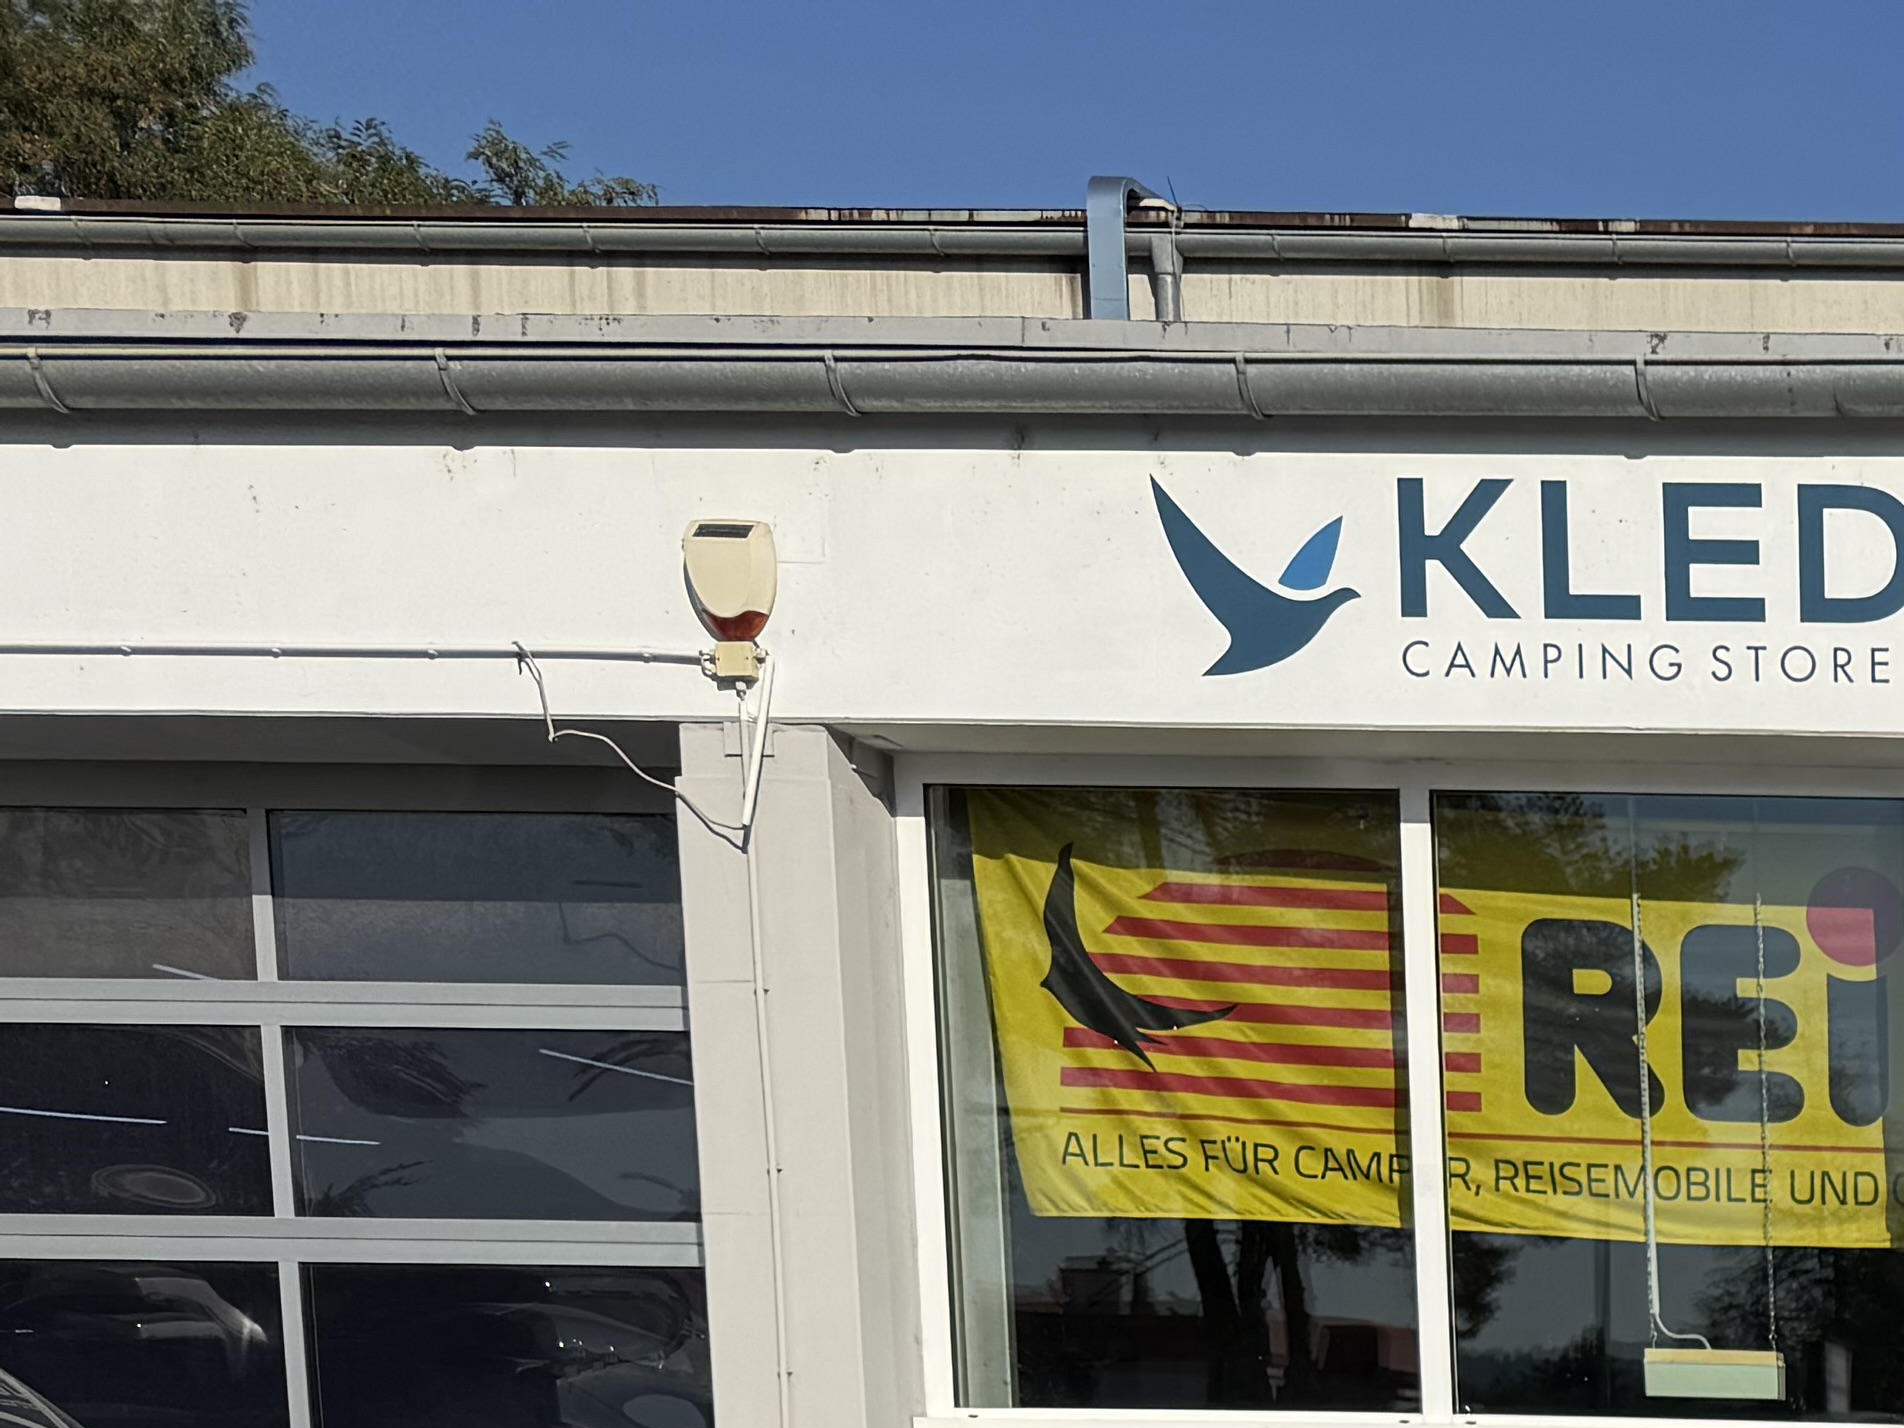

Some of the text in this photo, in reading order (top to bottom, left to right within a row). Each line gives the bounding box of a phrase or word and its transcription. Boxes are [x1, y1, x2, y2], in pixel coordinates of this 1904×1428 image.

[1401, 638, 1685, 683] CAMPING
[1709, 642, 1890, 686] STORE
[1060, 1130, 1188, 1171] ALLES
[1201, 1133, 1280, 1176] FÜR
[1293, 1144, 1482, 1198] CAMPR,
[1493, 1158, 1769, 1206] REISEMOBILE
[1788, 1168, 1880, 1207] UND
